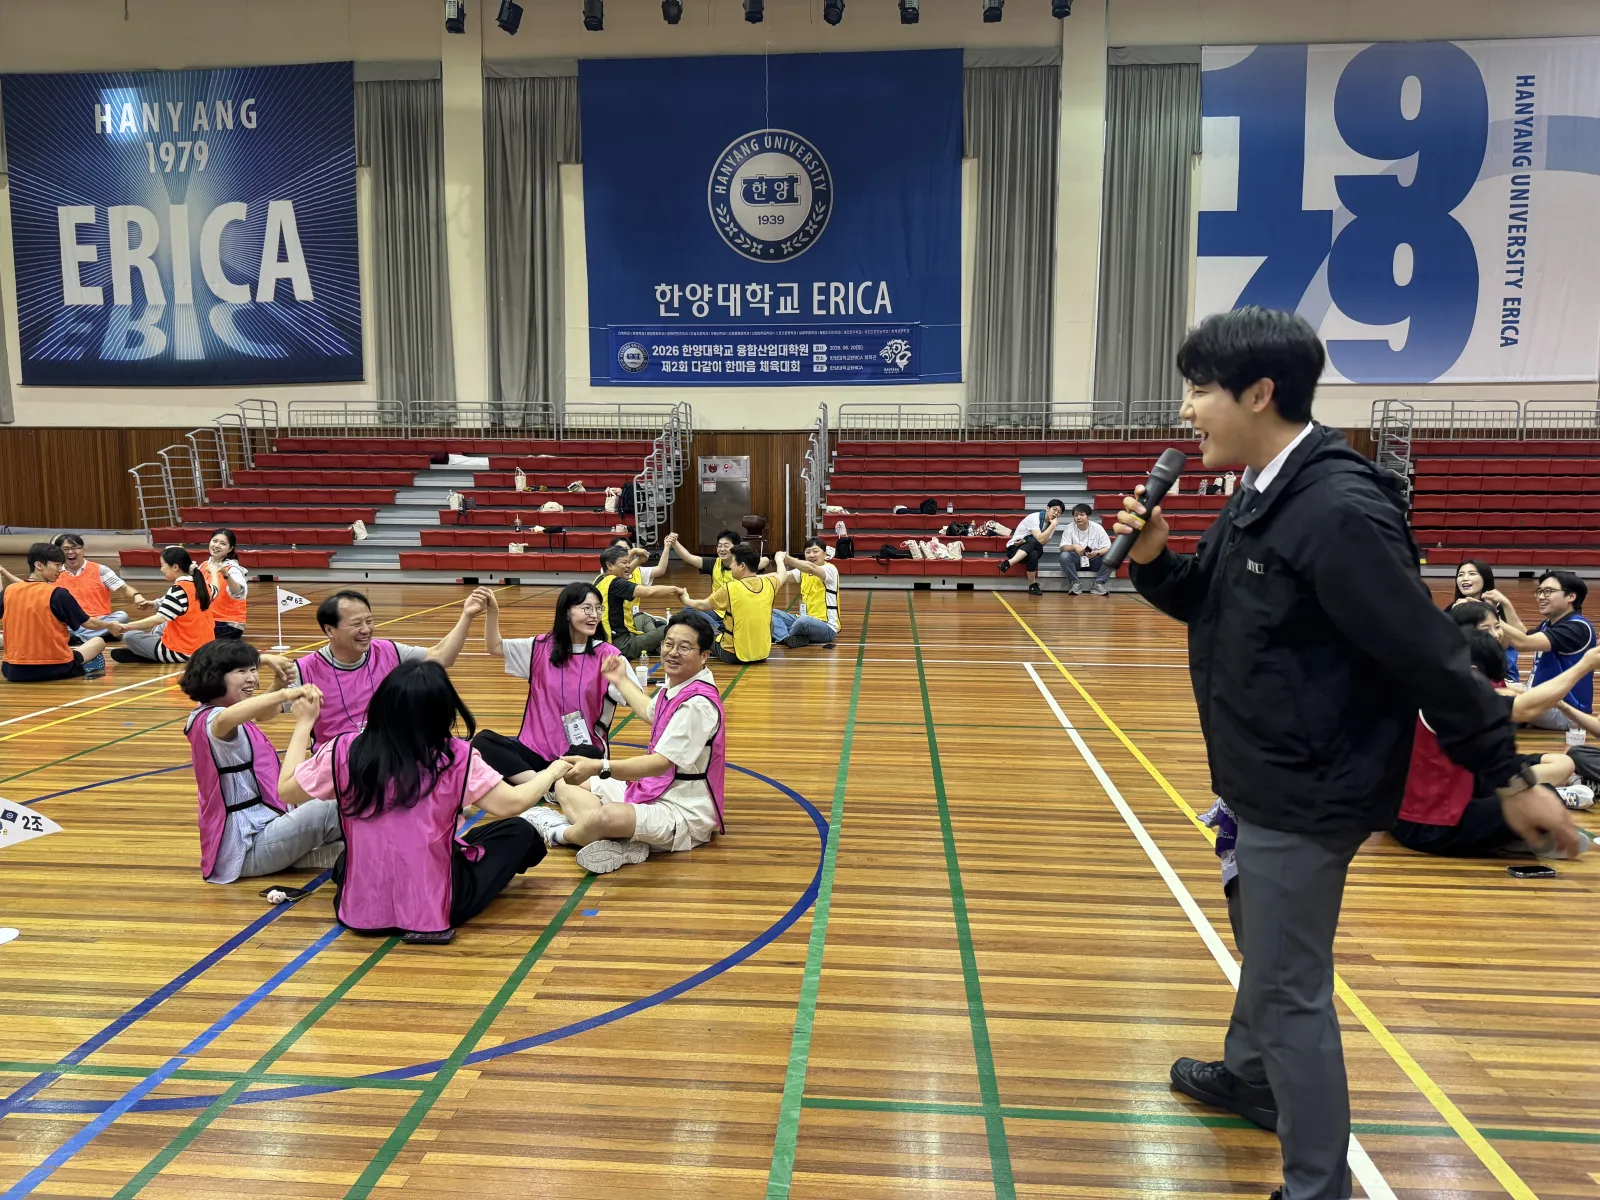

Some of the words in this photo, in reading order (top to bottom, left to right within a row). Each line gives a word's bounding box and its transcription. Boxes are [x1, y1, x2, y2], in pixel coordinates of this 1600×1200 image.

[94, 98, 258, 134] HANYANG
[1511, 75, 1536, 168] HANYANG
[145, 140, 210, 174] 1979
[714, 138, 761, 195] HANYANG
[764, 135, 828, 192] UNIVERSITY
[757, 214, 786, 226] 1939
[1504, 173, 1531, 290] UNIVERSITY
[57, 200, 314, 306] ERICA
[654, 282, 800, 317] 한양대학교
[812, 280, 893, 316] ERICA
[1499, 297, 1522, 348] ERICA
[652, 345, 680, 357] 2026
[682, 344, 734, 357] 한양대학교
[737, 343, 809, 357] 융합산업대학원
[661, 360, 688, 373] 제2회
[691, 360, 722, 373] 다같이
[725, 360, 757, 373] 한마음
[759, 359, 801, 373] 체육대회
[21, 815, 44, 833] 2조
